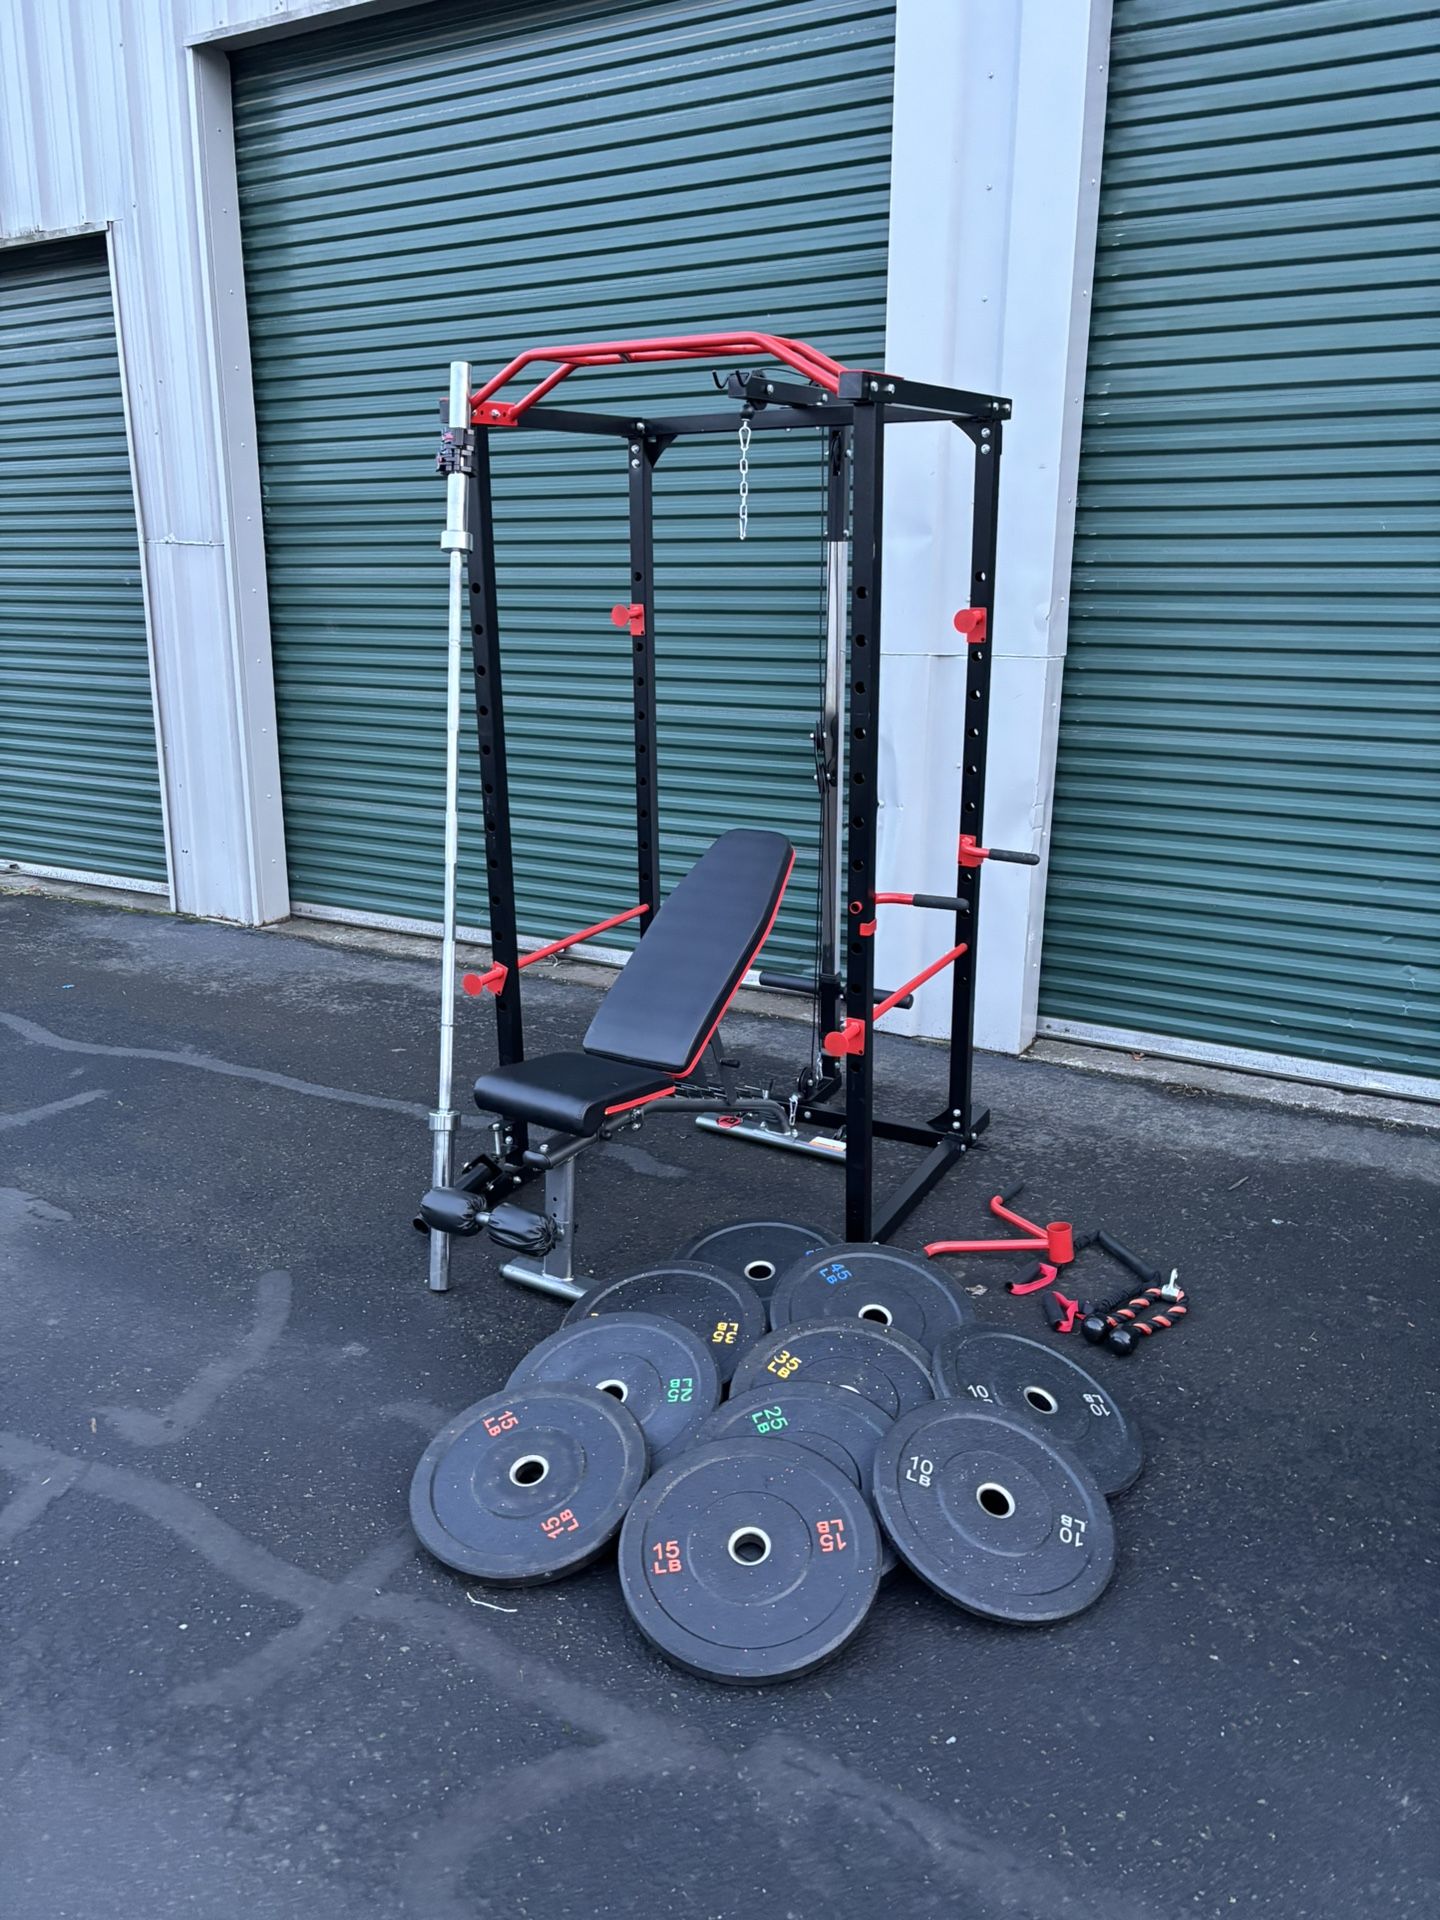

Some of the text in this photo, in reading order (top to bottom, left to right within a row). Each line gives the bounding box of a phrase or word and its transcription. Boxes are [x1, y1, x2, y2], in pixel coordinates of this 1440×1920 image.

[819, 1268, 838, 1284] LB
[831, 1264, 852, 1280] 45
[717, 1322, 739, 1331] LB
[712, 1331, 737, 1344] 35
[767, 1361, 791, 1378] LB
[773, 1350, 802, 1371] 35
[670, 1378, 693, 1388] LB
[967, 1384, 989, 1398] 10
[667, 1388, 693, 1402] 25
[1082, 1393, 1104, 1404] LB
[763, 1406, 788, 1429] 25
[1089, 1403, 1111, 1417] 10
[483, 1417, 501, 1436] LB
[498, 1411, 518, 1429] 15
[751, 1411, 770, 1433] LB
[910, 1456, 933, 1475] 10
[906, 1469, 931, 1487] LB
[541, 1517, 565, 1539] 15
[559, 1509, 579, 1531] LB
[816, 1519, 844, 1534] LB
[1060, 1514, 1086, 1533] LB
[819, 1533, 847, 1552] 15
[1059, 1527, 1084, 1547] 10
[653, 1540, 680, 1560] 15
[653, 1559, 682, 1575] LB
